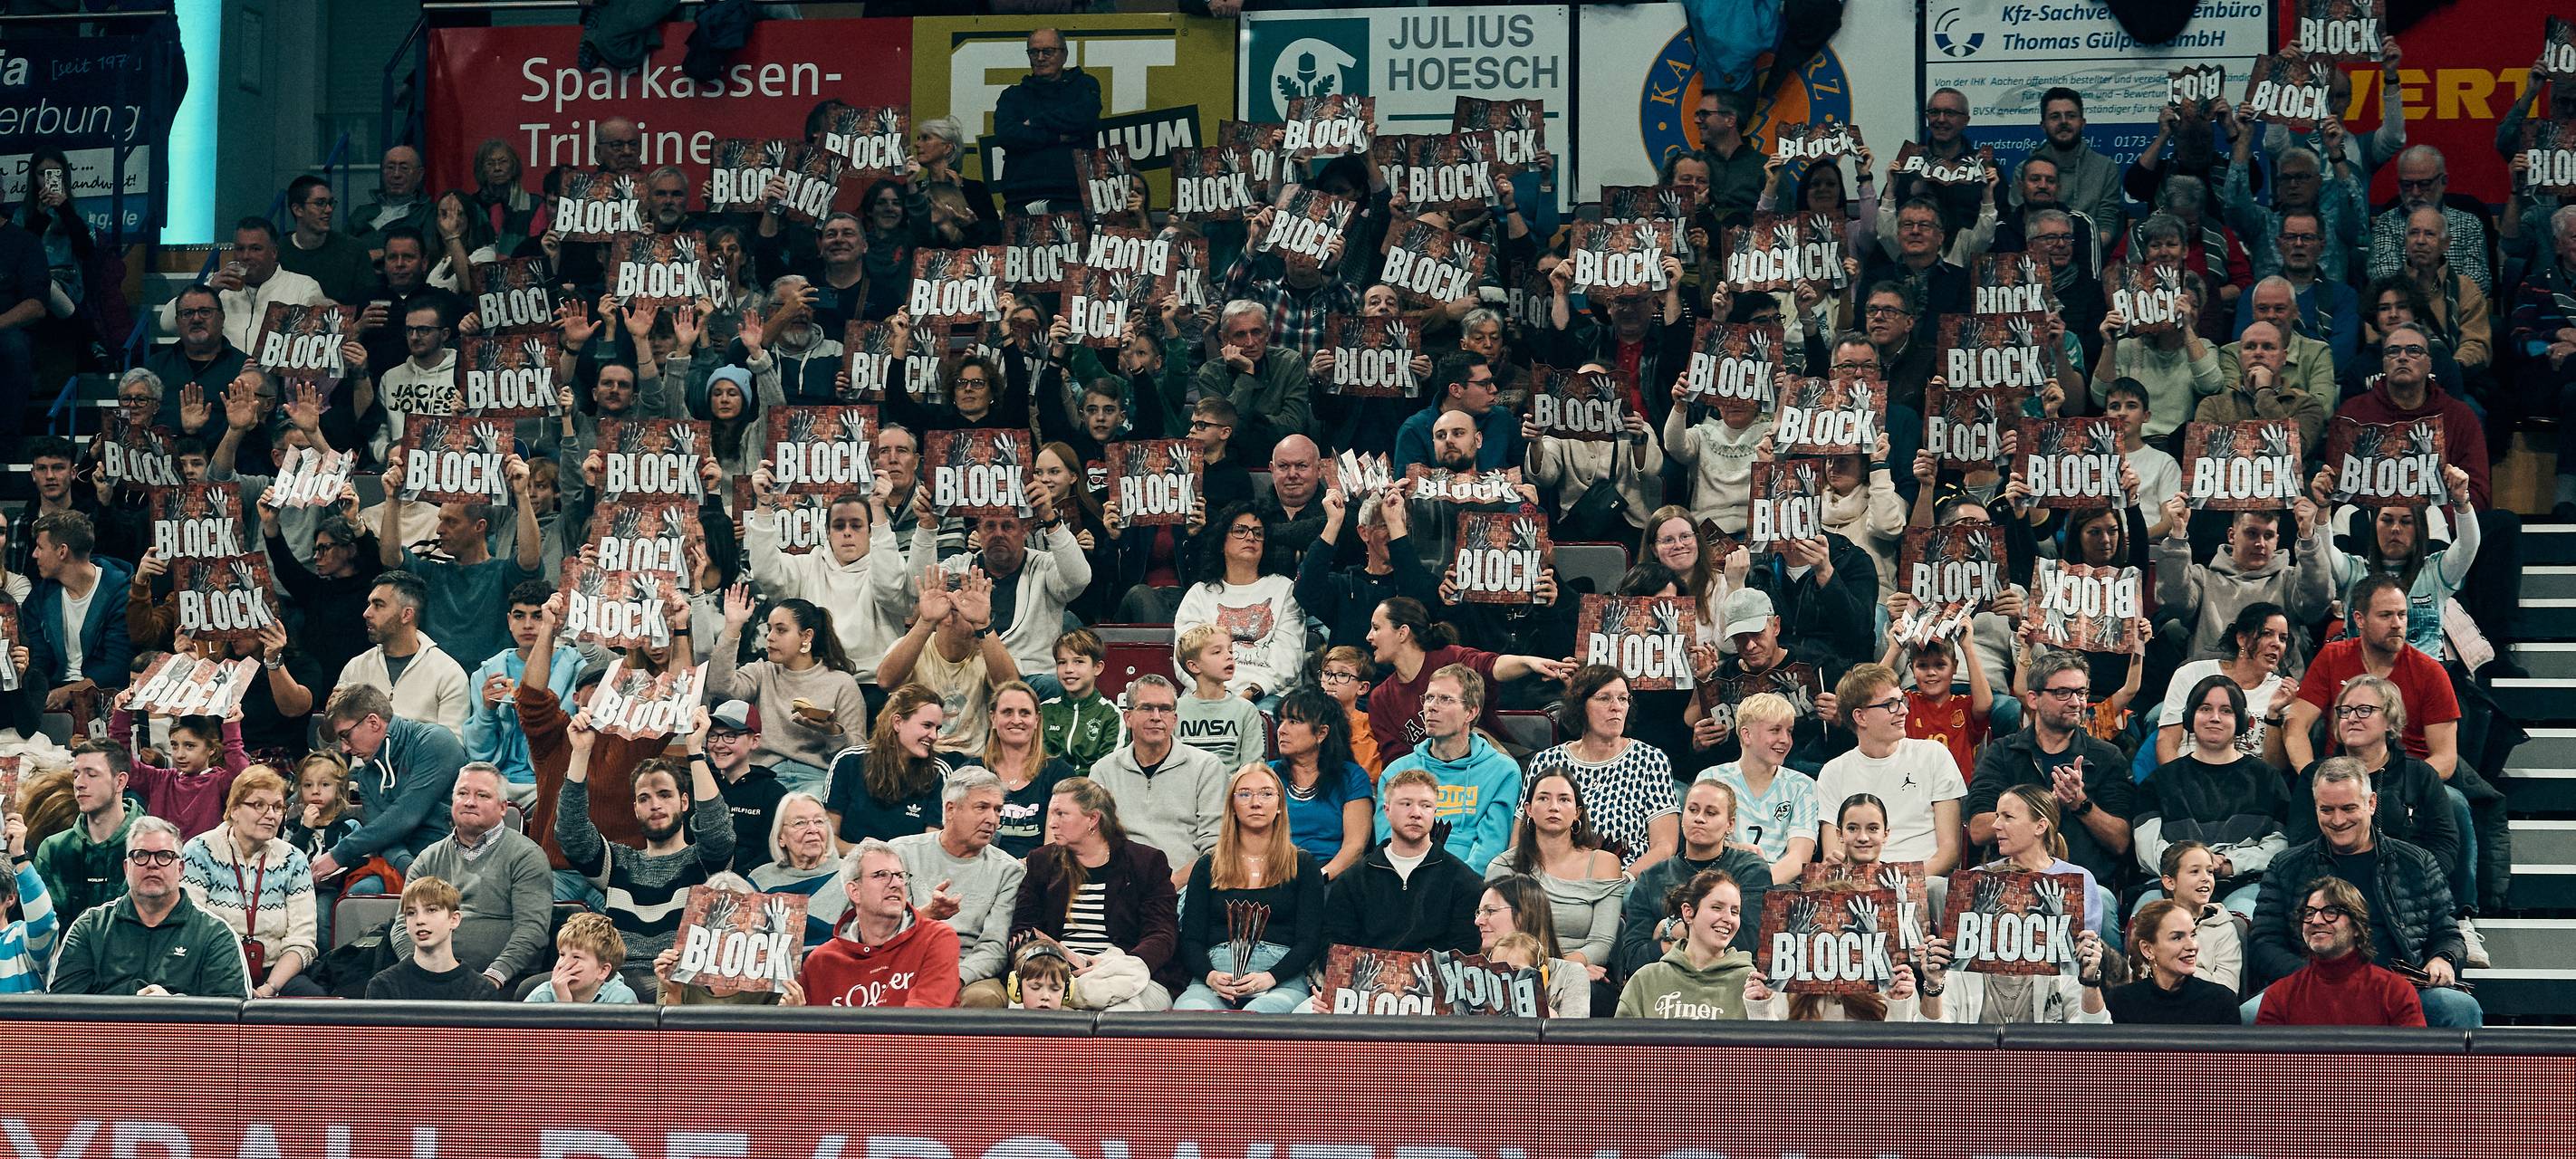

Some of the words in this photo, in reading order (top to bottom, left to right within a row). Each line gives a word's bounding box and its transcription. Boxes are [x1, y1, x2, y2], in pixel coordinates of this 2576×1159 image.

[1388, 14, 1534, 50] JULIUS
[2003, 33, 2081, 51] Thomas
[2300, 17, 2380, 55] BLOCK
[1388, 55, 1559, 91] HOESCH
[1935, 78, 1951, 87] Von
[1954, 77, 1968, 86] der
[1971, 77, 1986, 86] IHK
[1992, 76, 2024, 86] Aachen
[2114, 74, 2132, 83] und
[1973, 106, 1995, 115] BVSK
[2251, 80, 2331, 120] BLOCK
[1283, 117, 1365, 150] BLOCK
[1777, 131, 1860, 161] BLOCK
[1973, 138, 2037, 151] Landstraße
[1409, 160, 1494, 204] BLOCK
[1904, 155, 1986, 182] BLOCK
[784, 169, 840, 220] BLOCK
[1177, 172, 1250, 214] BLOCK
[554, 196, 640, 235] BLOCK
[616, 259, 704, 300] BLOCK
[1004, 241, 1079, 283] BLOCK
[1380, 244, 1474, 303] BLOCK
[1575, 246, 1665, 287] BLOCK
[1727, 244, 1801, 284] BLOCK
[909, 275, 997, 316] BLOCK
[261, 330, 343, 369] BLOCK
[1334, 346, 1415, 388] BLOCK
[1947, 345, 2043, 388] BLOCK
[466, 367, 556, 410] BLOCK
[1688, 351, 1773, 402] BLOCK
[1534, 393, 1628, 434] BLOCK
[1777, 405, 1876, 446] BLOCK
[104, 440, 182, 486] BLOCK
[406, 448, 504, 495] BLOCK
[606, 452, 700, 494] BLOCK
[775, 441, 871, 484] BLOCK
[2027, 453, 2121, 498] BLOCK
[2192, 454, 2296, 499] BLOCK
[2341, 452, 2442, 498] BLOCK
[935, 464, 1026, 508] BLOCK
[1120, 472, 1195, 517] BLOCK
[1418, 475, 1515, 501] BLOCK
[154, 516, 240, 560] BLOCK
[1456, 548, 1541, 593] BLOCK
[1912, 560, 1999, 604] BLOCK
[178, 586, 272, 631] BLOCK
[567, 588, 665, 639] BLOCK
[2040, 569, 2136, 619] BLOCK
[1587, 632, 1687, 679] BLOCK
[595, 686, 691, 733] BLOCK
[1180, 718, 1239, 737] NASA
[730, 806, 762, 816] HILFIGER
[679, 924, 794, 979] BLOCK
[1772, 931, 1889, 982] BLOCK
[1955, 912, 2072, 964] BLOCK
[1653, 992, 1725, 1020] Finer
